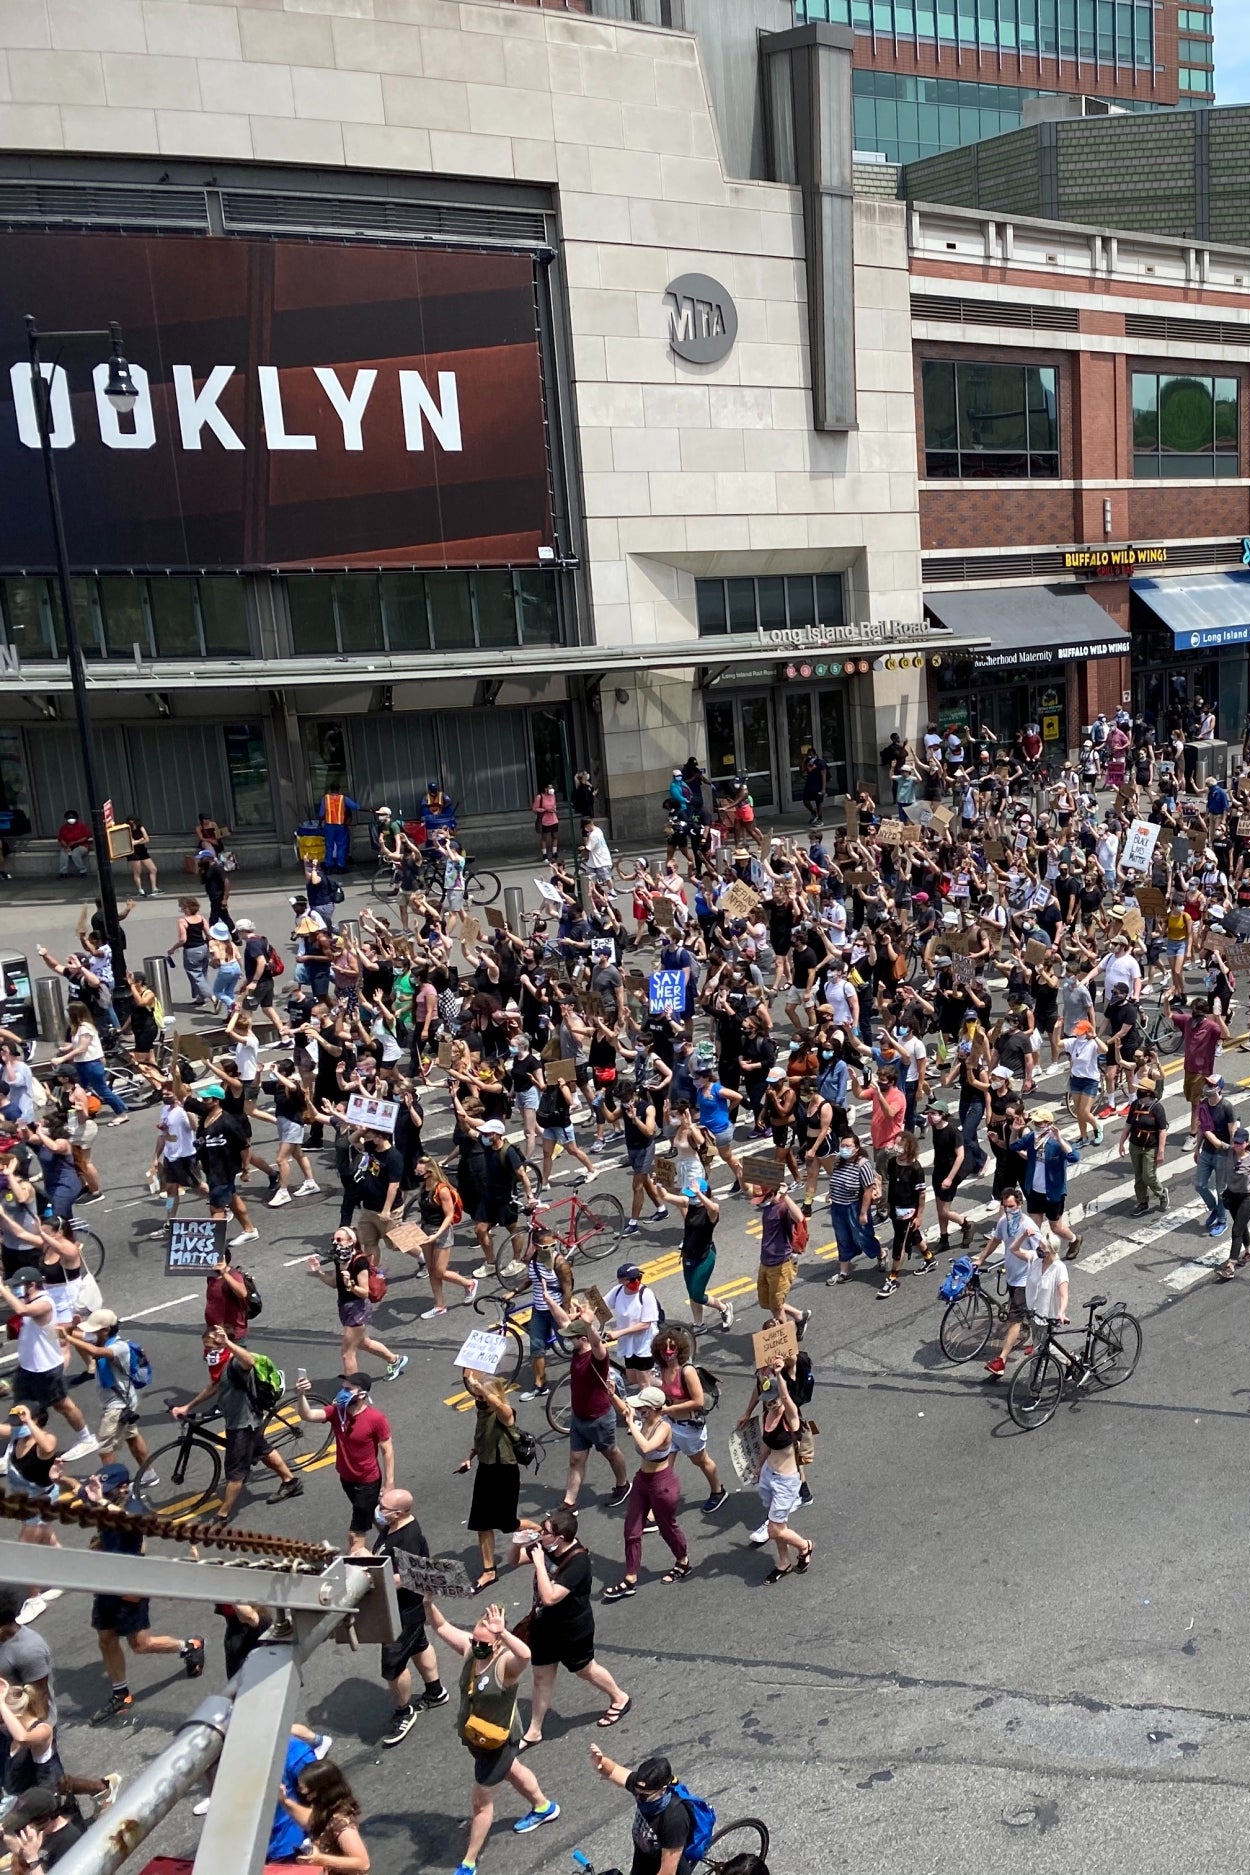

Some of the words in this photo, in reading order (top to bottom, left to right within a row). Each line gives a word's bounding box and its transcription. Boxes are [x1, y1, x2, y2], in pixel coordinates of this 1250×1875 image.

[667, 289, 728, 342] MTA
[1065, 551, 1109, 568] BUFFALO
[1111, 549, 1136, 565] WILD
[1137, 547, 1167, 562] WINGS
[759, 626, 801, 645] Long
[805, 622, 856, 641] Island
[860, 620, 891, 638] Rail
[893, 617, 930, 637] Road
[1202, 632, 1222, 644] Long
[1223, 629, 1247, 641] Island
[1019, 650, 1053, 665] Maternity
[1058, 646, 1089, 659] BUFFALO
[1090, 644, 1108, 657] WILD
[1108, 642, 1130, 655] WINGS
[1133, 833, 1149, 846] BLACK
[727, 893, 747, 914] NYPD
[653, 971, 681, 988] SAY
[656, 985, 682, 999] HER
[650, 996, 682, 1012] NAME
[172, 1221, 216, 1236] BLACK
[171, 1234, 216, 1252] LIVES
[169, 1250, 220, 1266] MATTER
[762, 1328, 786, 1342] WHITE
[763, 1335, 788, 1352] SILENCE
[478, 1351, 499, 1364] MIND
[409, 1557, 453, 1572] BLACK
[414, 1581, 464, 1597] MATTER
